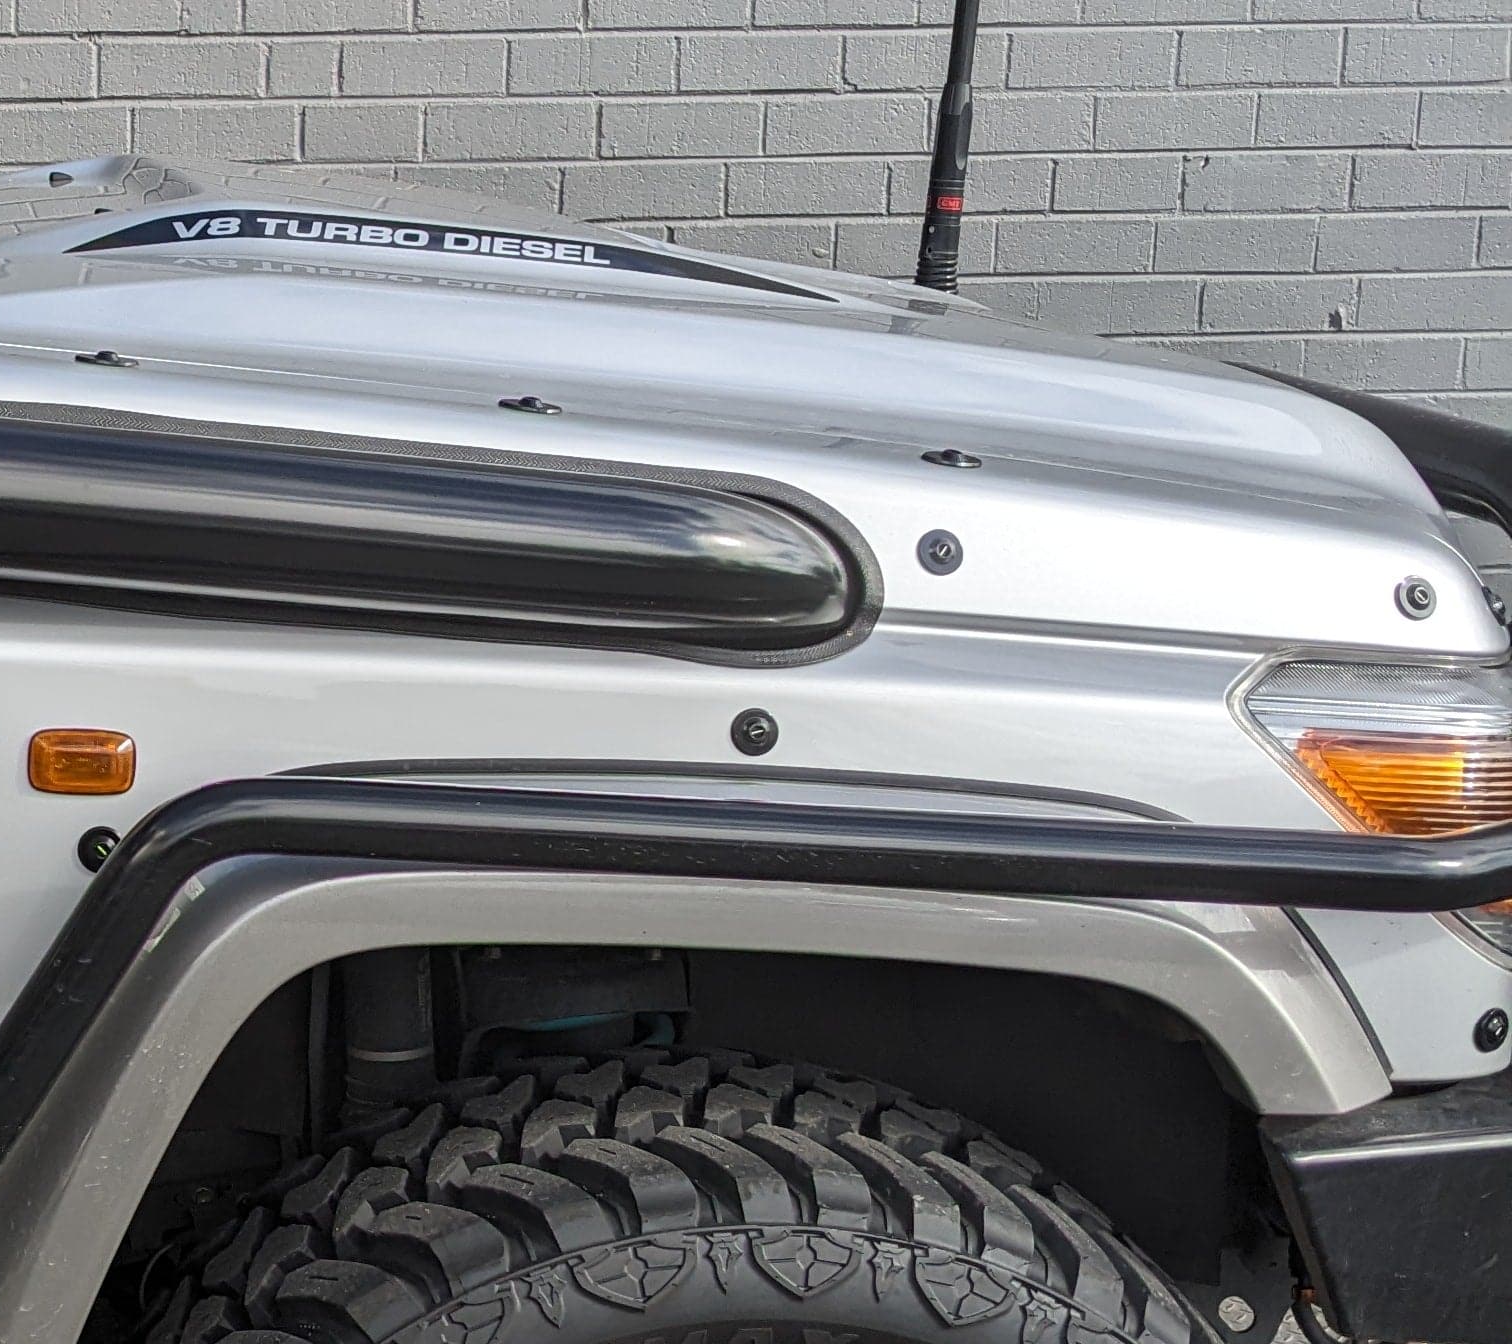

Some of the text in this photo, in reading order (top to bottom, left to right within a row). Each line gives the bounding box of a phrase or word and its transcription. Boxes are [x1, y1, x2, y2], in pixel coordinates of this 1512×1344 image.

[171, 217, 610, 264] V8 TURBO DIESEL
